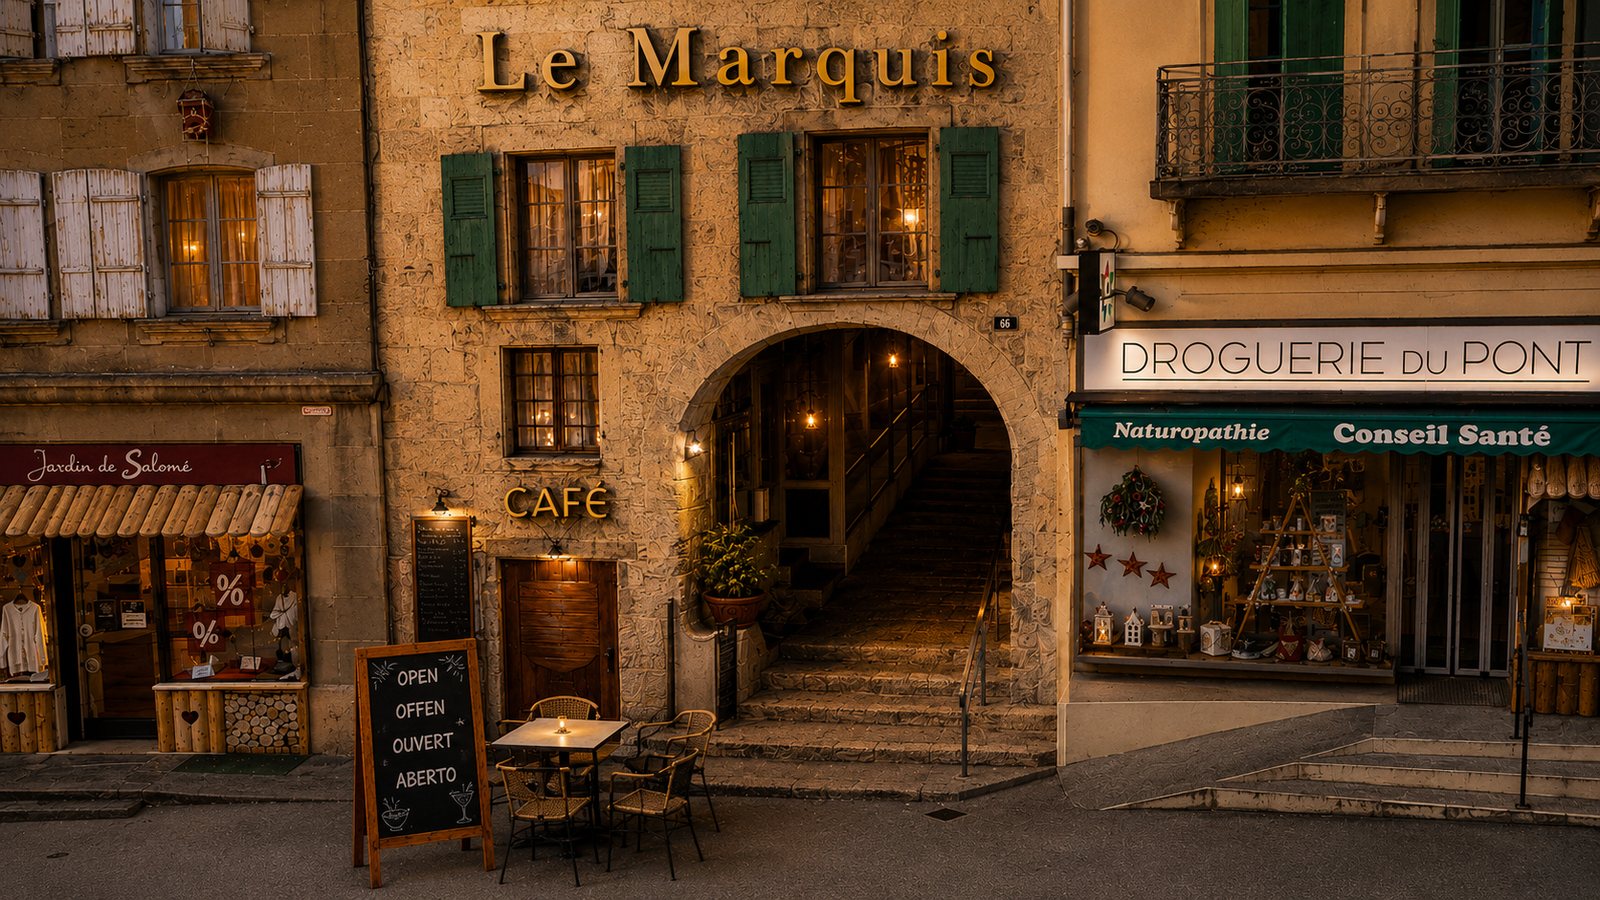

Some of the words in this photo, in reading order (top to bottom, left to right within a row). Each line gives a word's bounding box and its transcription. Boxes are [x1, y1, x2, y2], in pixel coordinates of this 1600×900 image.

[477, 30, 579, 93] Le
[626, 26, 998, 105] Marquis
[999, 318, 1011, 329] 66
[1121, 341, 1385, 376] DROGUERIE
[1401, 349, 1448, 376] DU
[1462, 341, 1592, 376] PONT
[1112, 421, 1271, 444] Naturopathie
[1333, 423, 1449, 446] Conseil
[1458, 424, 1552, 447] Santé
[27, 449, 94, 482] Jardin
[98, 454, 117, 473] de
[121, 448, 193, 480] Salomé
[503, 482, 609, 520] CAFÉ
[216, 573, 244, 606] %
[192, 619, 219, 647] %
[397, 667, 439, 687] OPEN
[395, 699, 446, 719] OFFEN
[392, 731, 454, 754] OUVERT
[395, 766, 457, 790] ABERTO
